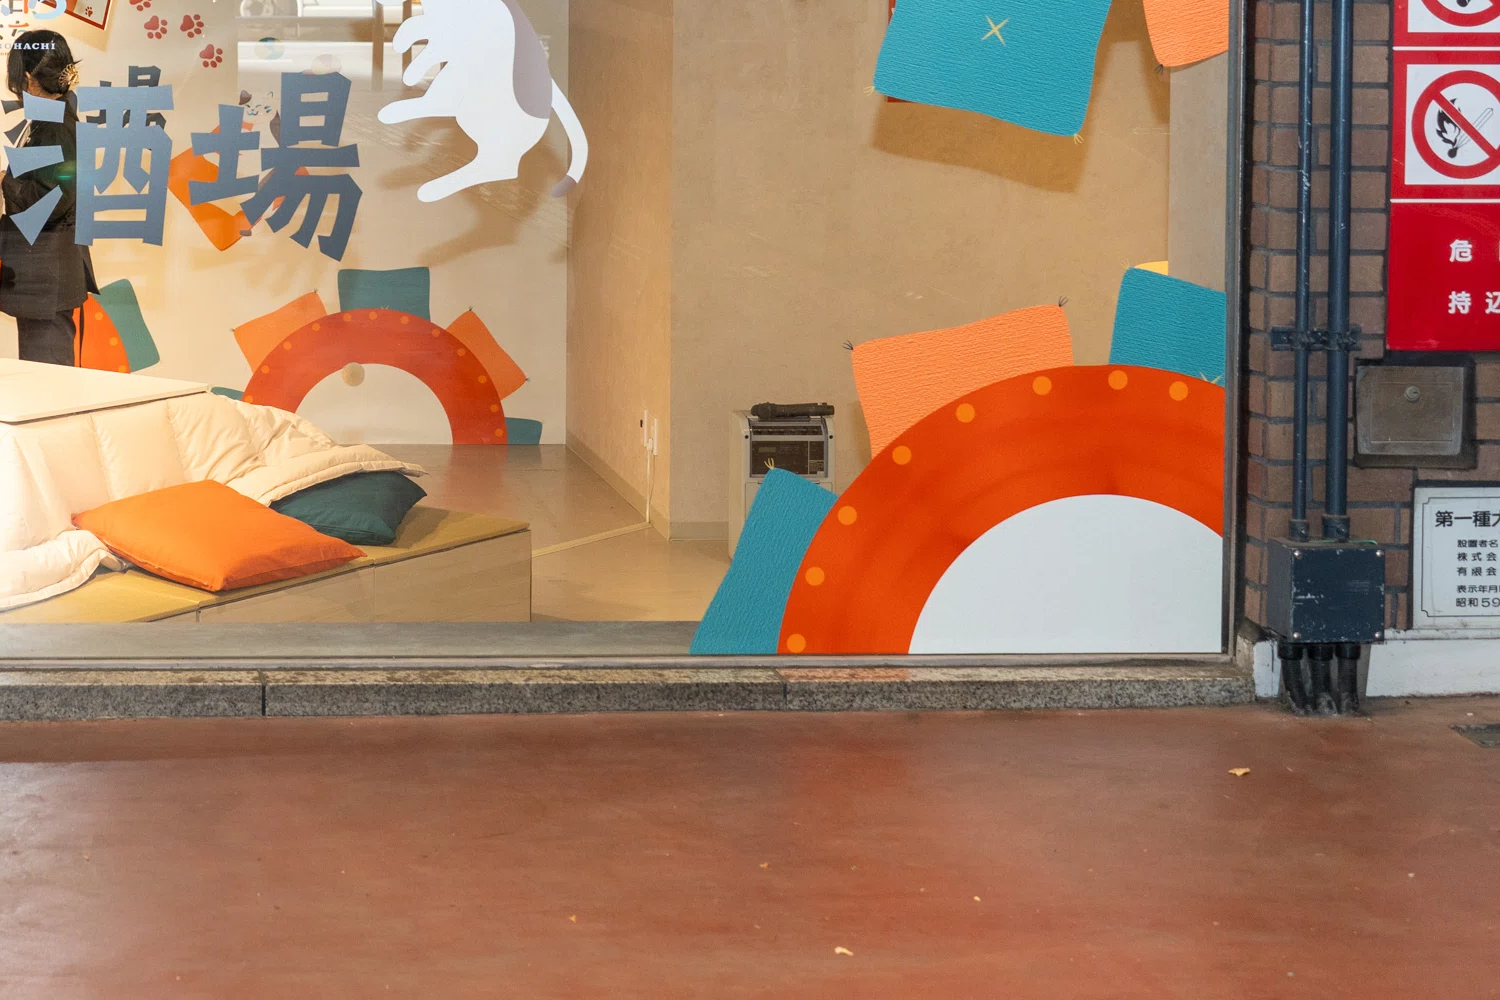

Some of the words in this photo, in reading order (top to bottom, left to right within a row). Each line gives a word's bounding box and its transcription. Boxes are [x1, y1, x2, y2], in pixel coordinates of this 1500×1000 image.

[1457, 539, 1499, 548] 設置者名
[1457, 552, 1497, 562] 株式会
[1456, 584, 1500, 594] 表示年月
